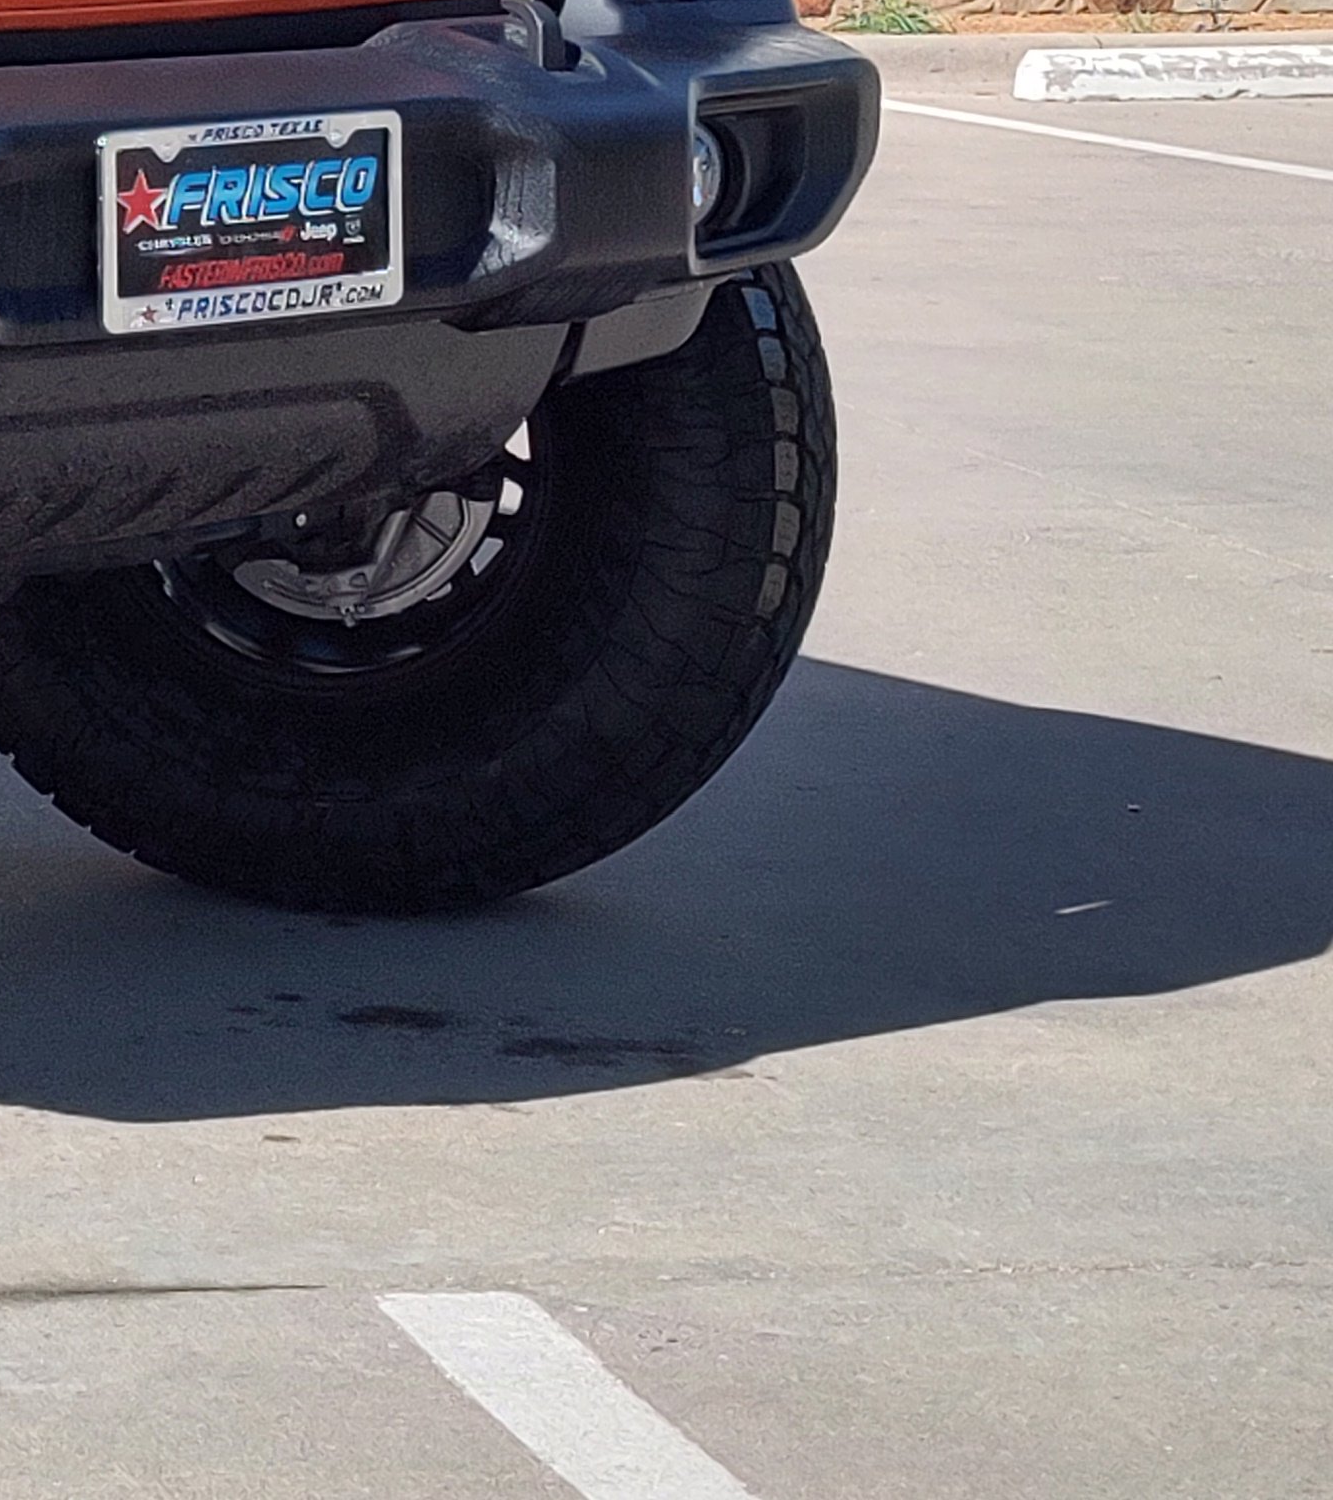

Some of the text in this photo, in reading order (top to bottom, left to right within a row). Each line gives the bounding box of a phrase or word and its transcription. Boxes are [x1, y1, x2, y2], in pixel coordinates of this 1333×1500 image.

[201, 124, 265, 141] FRISCO
[162, 156, 379, 230] FRISCO
[299, 221, 338, 242] Jeep
